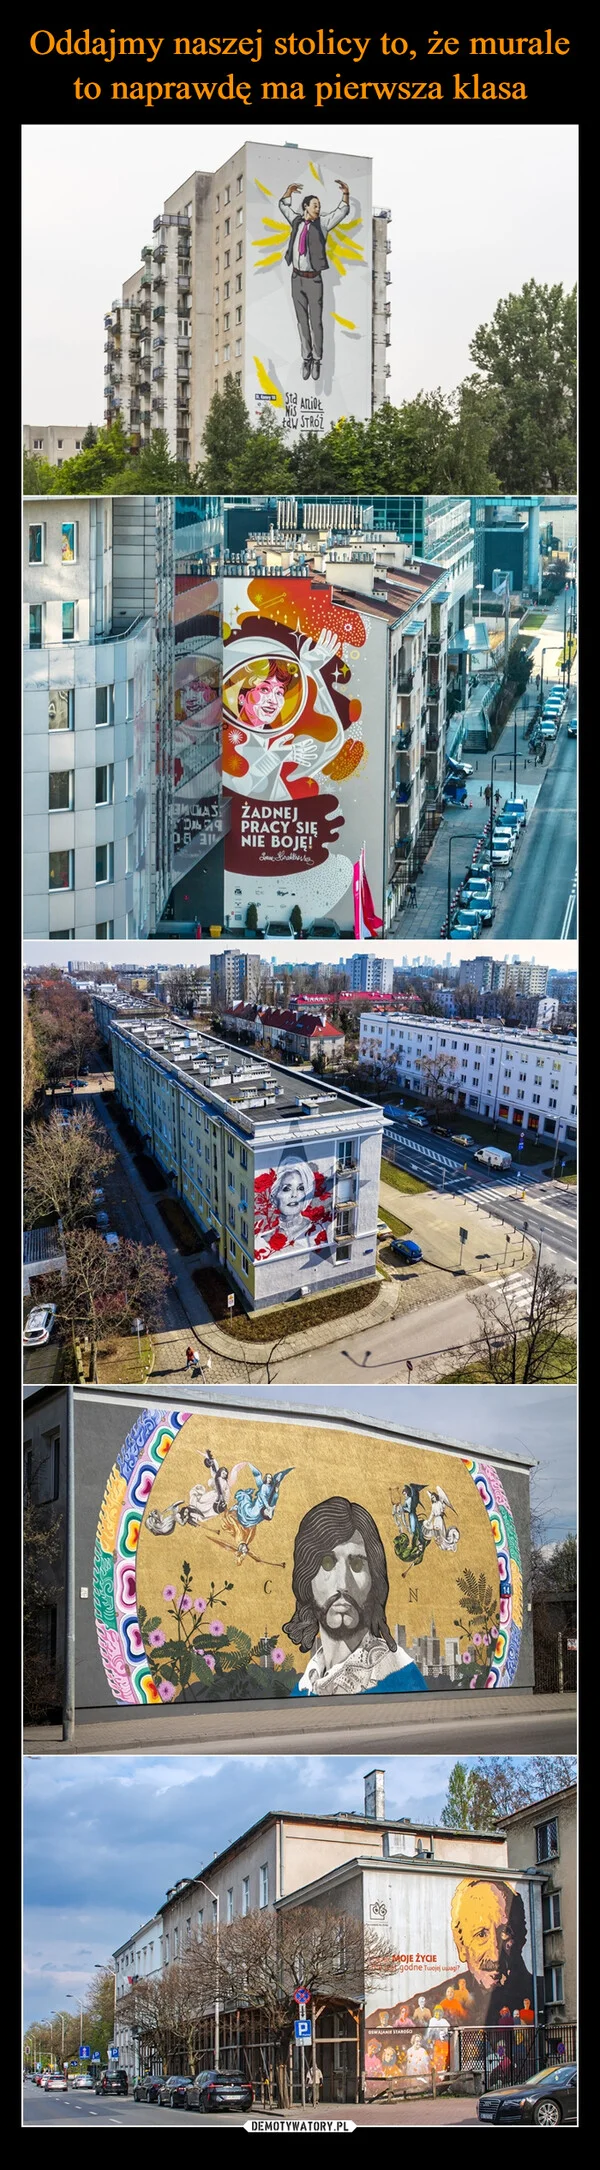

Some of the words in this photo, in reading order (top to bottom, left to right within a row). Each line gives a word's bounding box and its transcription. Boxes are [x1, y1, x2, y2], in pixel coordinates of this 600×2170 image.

[241, 801, 298, 822] ŻADNEJ
[241, 820, 290, 834] PRACY
[296, 821, 318, 838] SIĘ
[241, 835, 265, 848] NIE
[271, 835, 313, 852] BOJĘ!
[263, 1580, 273, 1595] C
[408, 1587, 419, 1603] N
[503, 1586, 510, 1595] 14
[392, 1953, 414, 1964] MOJE
[415, 1952, 437, 1963] ŻYCIE
[400, 1963, 423, 1974] godne
[298, 2022, 308, 2036] P
